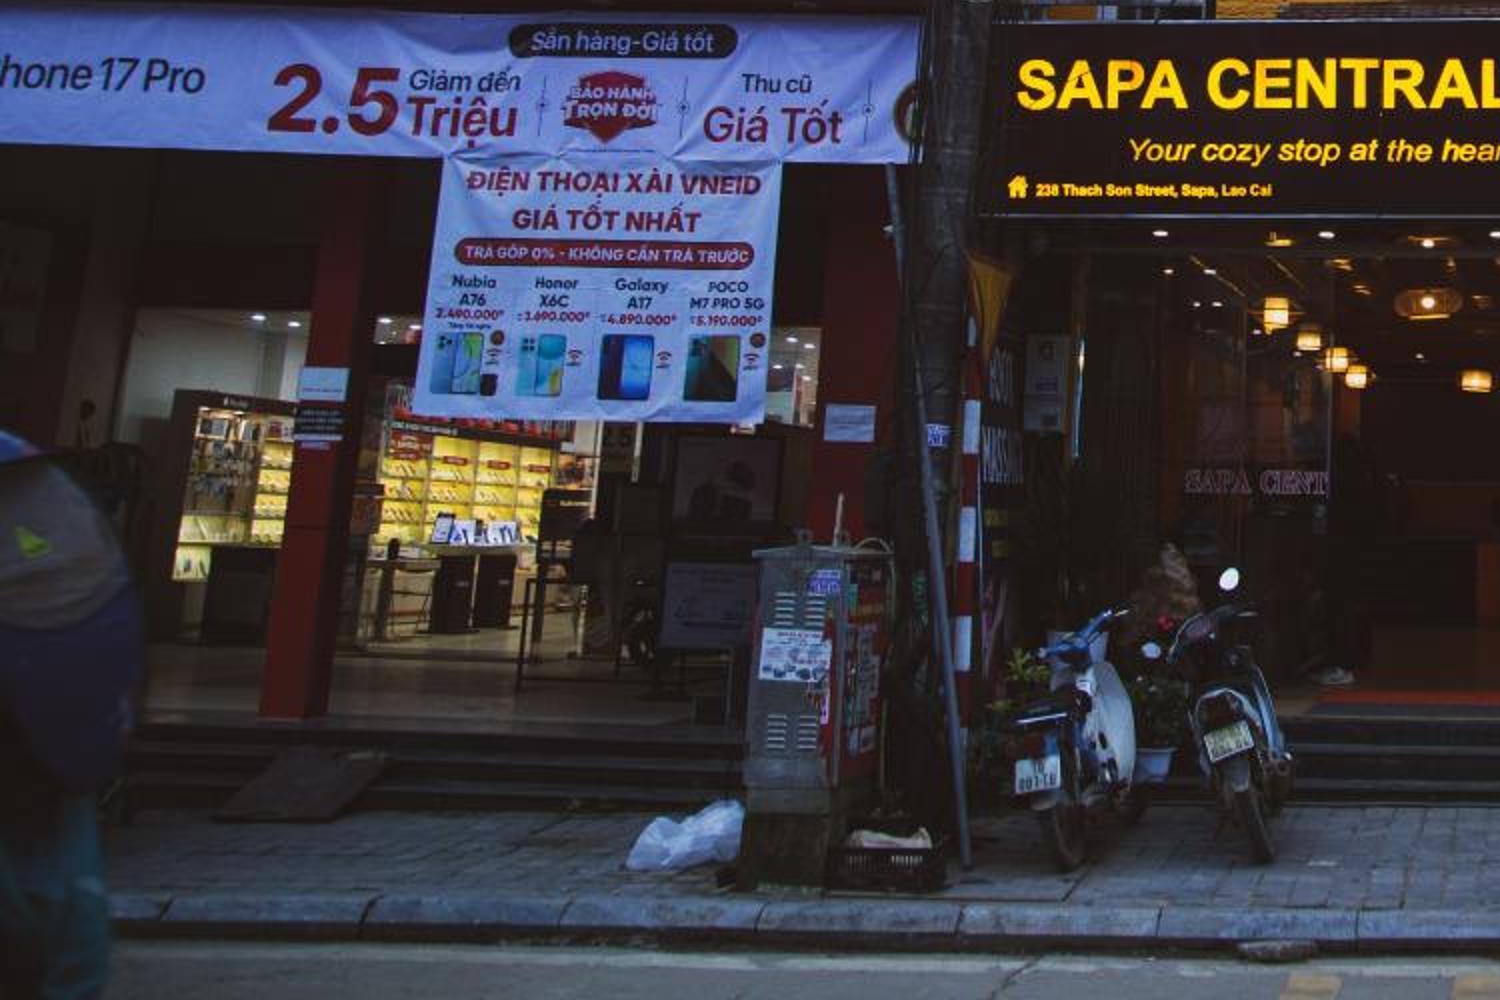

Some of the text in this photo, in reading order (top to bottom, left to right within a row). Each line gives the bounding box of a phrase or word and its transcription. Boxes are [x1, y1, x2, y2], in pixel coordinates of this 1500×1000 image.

[101, 57, 140, 92] 17
[143, 58, 205, 95] Pro
[409, 66, 521, 93] Giảm đến
[743, 73, 812, 95] Thu cũ
[1017, 57, 1189, 110] SAPA
[267, 62, 400, 137] 2.5
[408, 95, 517, 149] Triệu
[704, 99, 843, 144] Giá Tốt
[1129, 138, 1195, 163] Your
[1201, 143, 1271, 168] cozy
[1278, 140, 1341, 167] stop
[1349, 140, 1378, 163] at
[1386, 138, 1432, 163] the
[466, 166, 529, 196] ĐIỆN
[538, 172, 619, 199] THOẠI
[681, 174, 761, 196] VNEID
[1062, 184, 1102, 197] Thach
[1106, 185, 1131, 197] Son
[1135, 185, 1178, 199] Street,
[1181, 185, 1219, 199] Sapa,
[1222, 184, 1246, 197] Lao
[1250, 184, 1272, 197] Cai
[512, 200, 702, 234] GIÁ TỐT NHẤT
[452, 274, 497, 289] Nubia
[535, 276, 580, 290] Honor
[615, 277, 669, 295] Galaxy
[707, 281, 749, 293] POCO
[712, 297, 741, 310] PRO
